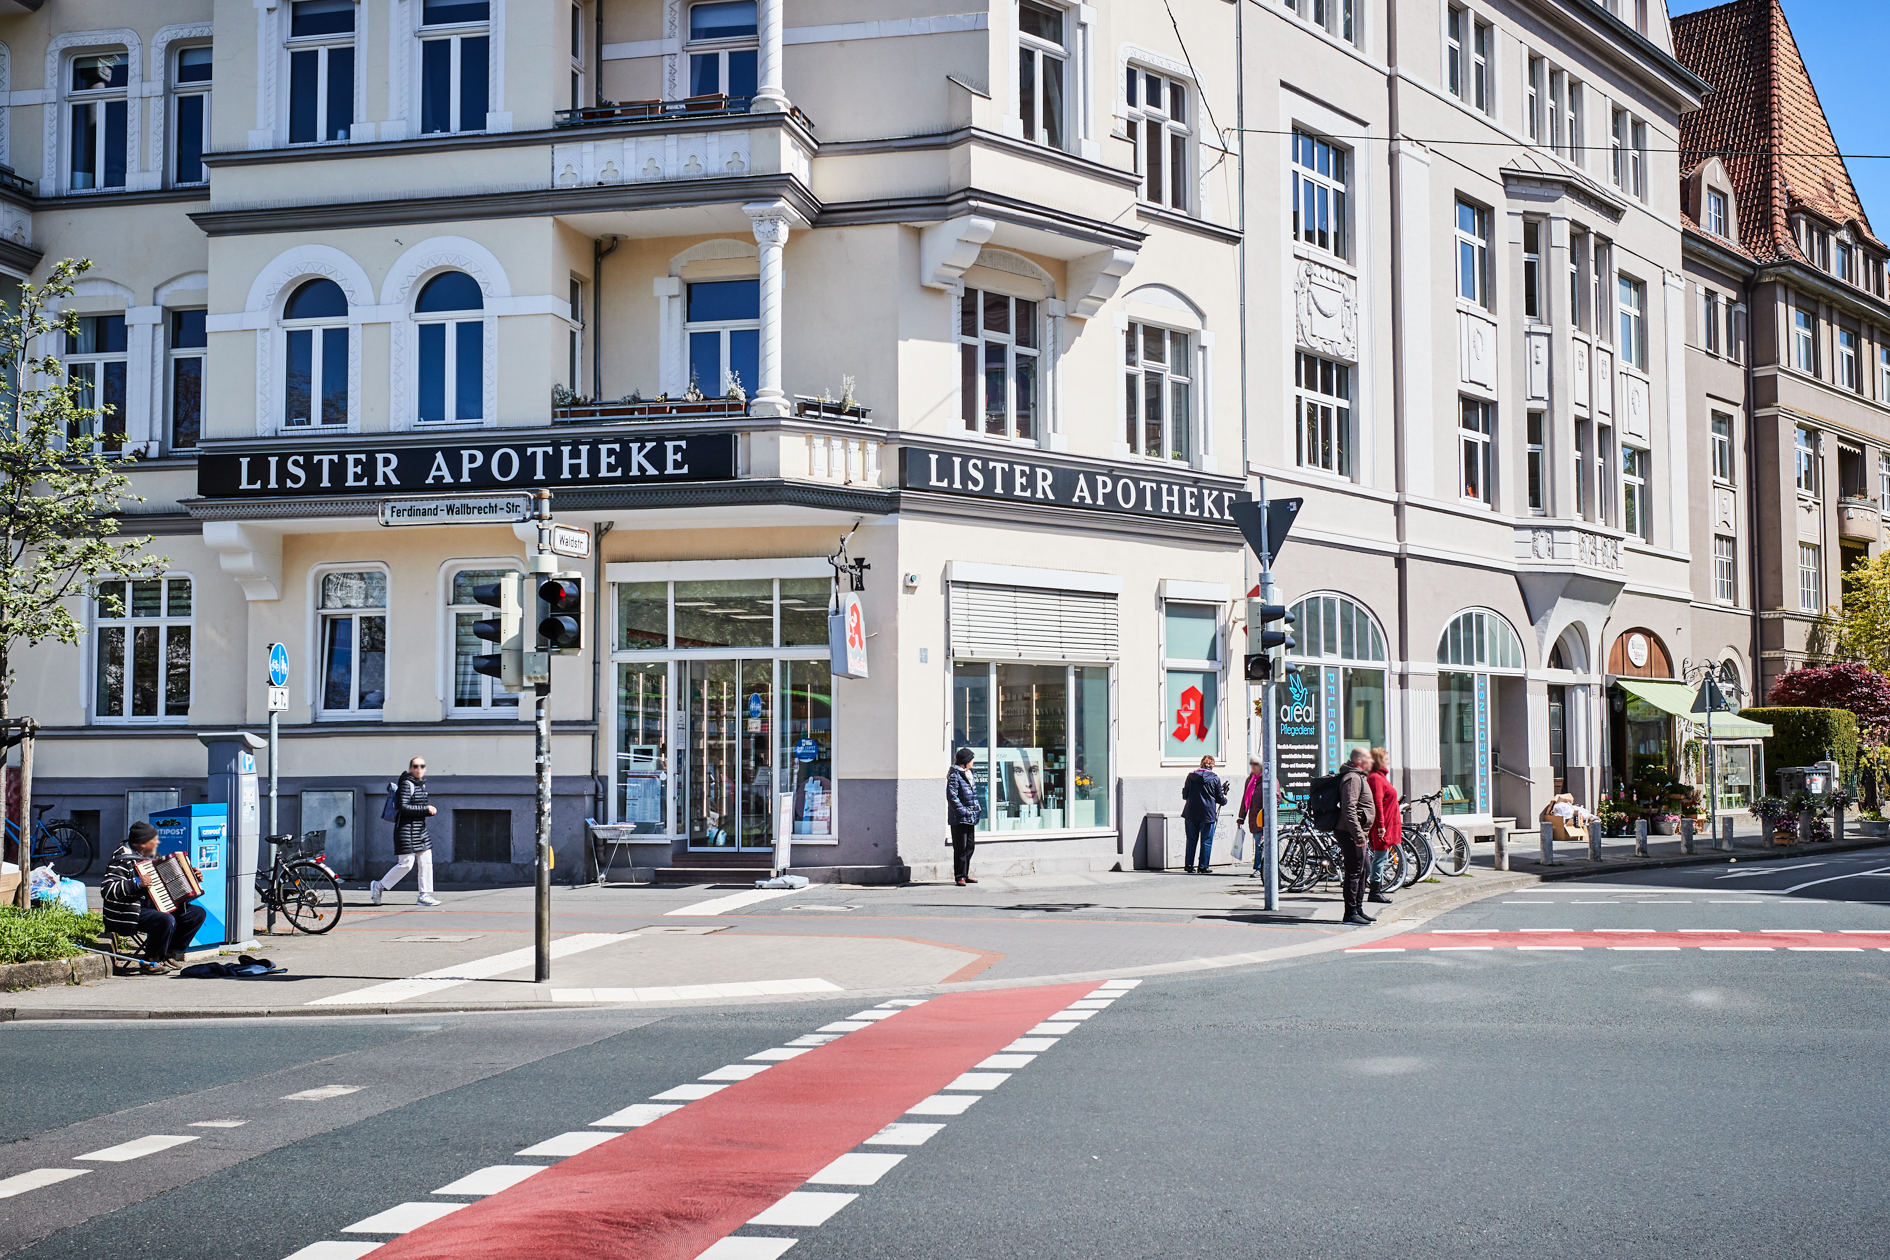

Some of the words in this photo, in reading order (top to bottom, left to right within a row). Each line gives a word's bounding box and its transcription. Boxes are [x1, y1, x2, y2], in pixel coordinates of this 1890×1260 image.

[238, 453, 401, 490] LISTER
[425, 440, 689, 484] APOTHEKE
[928, 453, 1055, 500] LISTER
[1072, 473, 1236, 521] APOTHEKE
[390, 503, 521, 518] Ferdinand-Wallbrecht-Str.
[558, 533, 584, 550] Waldstr.
[1280, 693, 1315, 723] areal
[1280, 723, 1315, 737] Pflegedienst
[1478, 680, 1487, 808] PFLEGEDIENST
[245, 754, 253, 771] P
